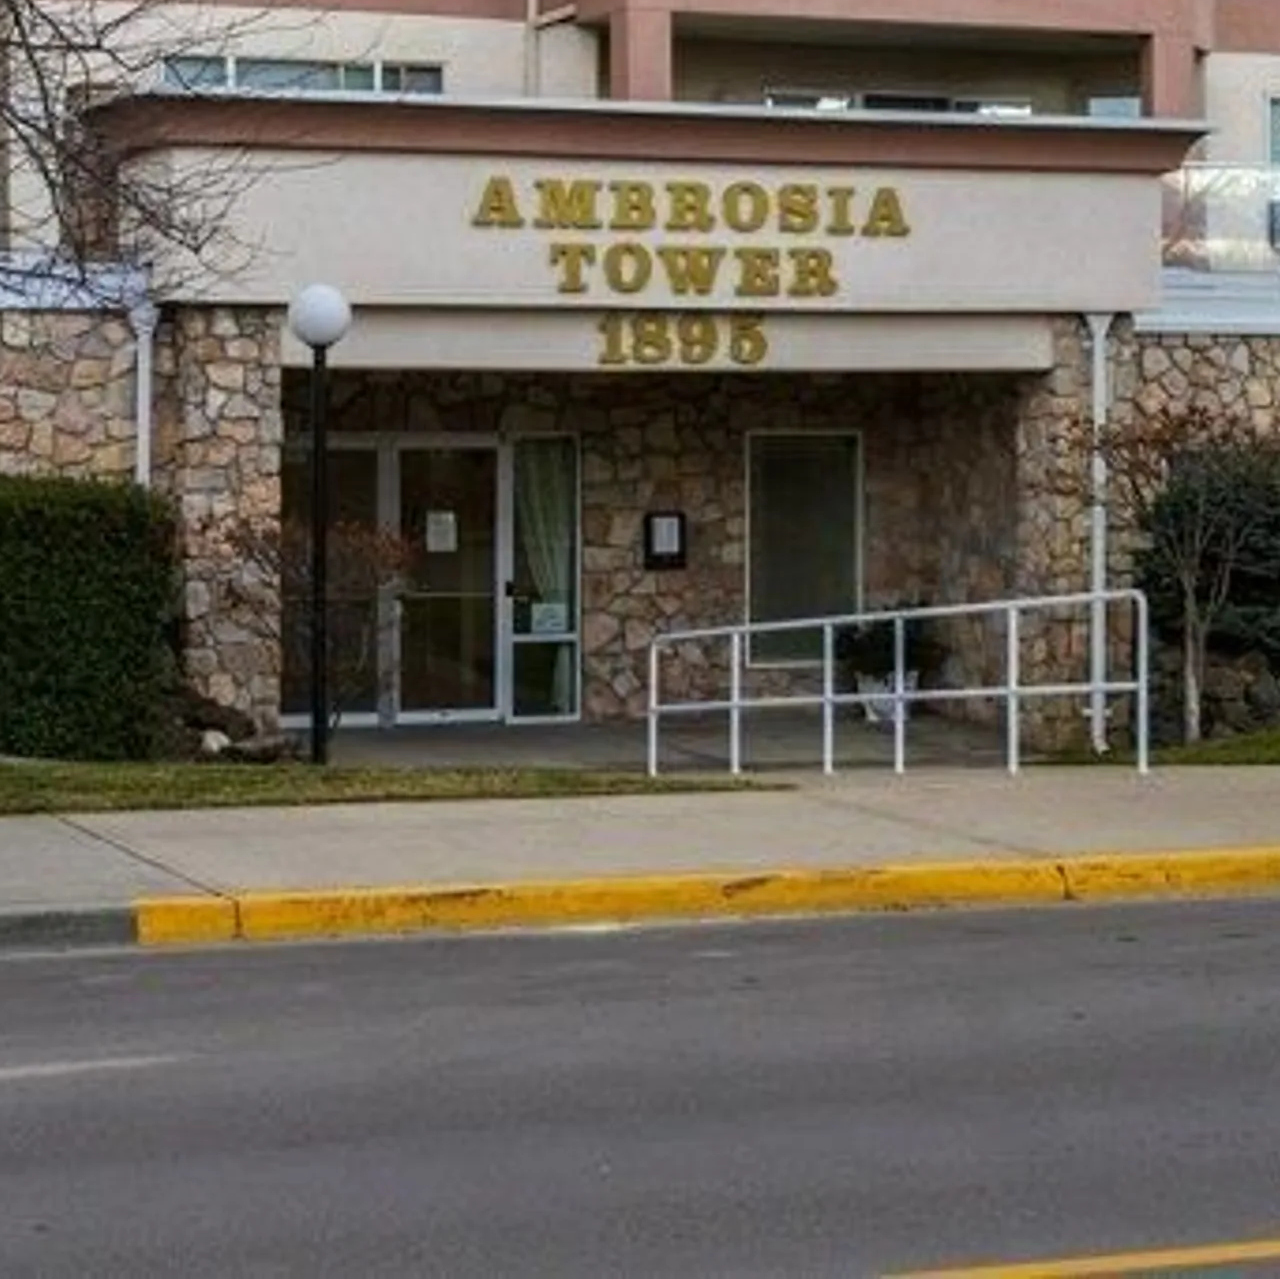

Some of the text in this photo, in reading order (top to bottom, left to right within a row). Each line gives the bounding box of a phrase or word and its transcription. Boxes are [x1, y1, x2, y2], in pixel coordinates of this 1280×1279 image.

[471, 175, 911, 238] AMBROSIA
[549, 242, 839, 297] TOWER
[596, 311, 770, 366] 1895
